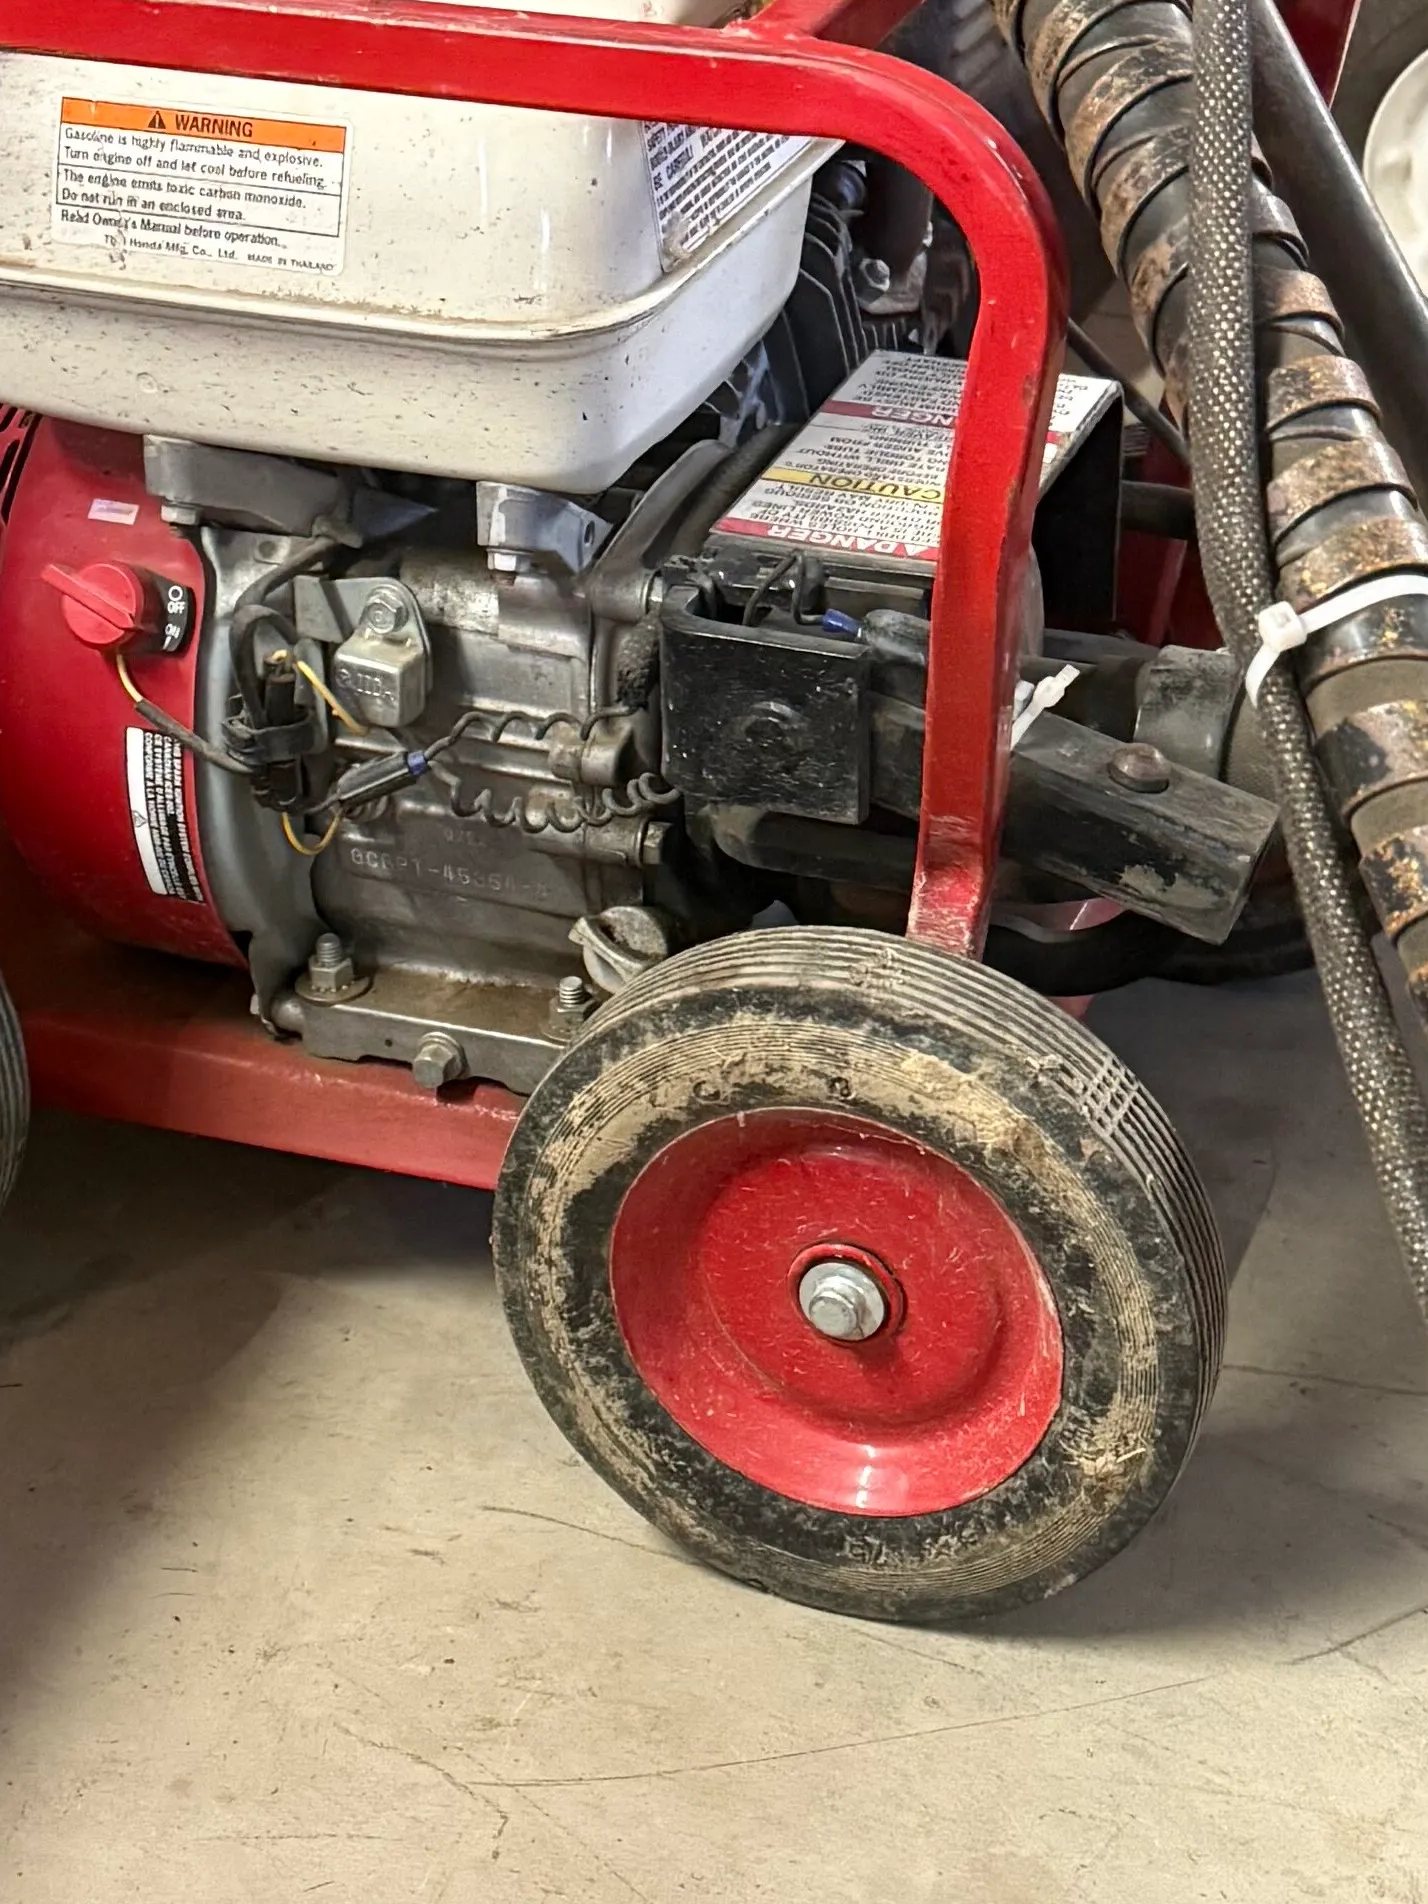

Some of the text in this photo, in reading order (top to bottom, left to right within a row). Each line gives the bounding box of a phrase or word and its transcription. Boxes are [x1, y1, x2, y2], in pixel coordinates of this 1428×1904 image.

[175, 114, 253, 138] WARNING
[65, 127, 322, 167] Gasoline is highly flammable and explosive.
[64, 146, 89, 160] Turn
[136, 154, 152, 167] off
[156, 158, 177, 170] and
[181, 160, 196, 173] let
[201, 162, 224, 176] cool
[229, 165, 268, 181] before
[64, 169, 306, 209] The engine emits toxic carbon monoxide.
[62, 188, 79, 201] Do
[81, 192, 100, 204] not
[103, 194, 123, 206] run
[142, 198, 155, 210] an
[160, 199, 212, 217] enclosed
[216, 206, 246, 220] area.
[61, 210, 89, 224] Read
[141, 218, 181, 234] Manual
[184, 223, 220, 240] before
[868, 405, 957, 425] NGER
[806, 473, 946, 500] CAUTION
[762, 524, 901, 552] DANGER
[167, 601, 186, 614] OFF
[165, 623, 180, 639] ON
